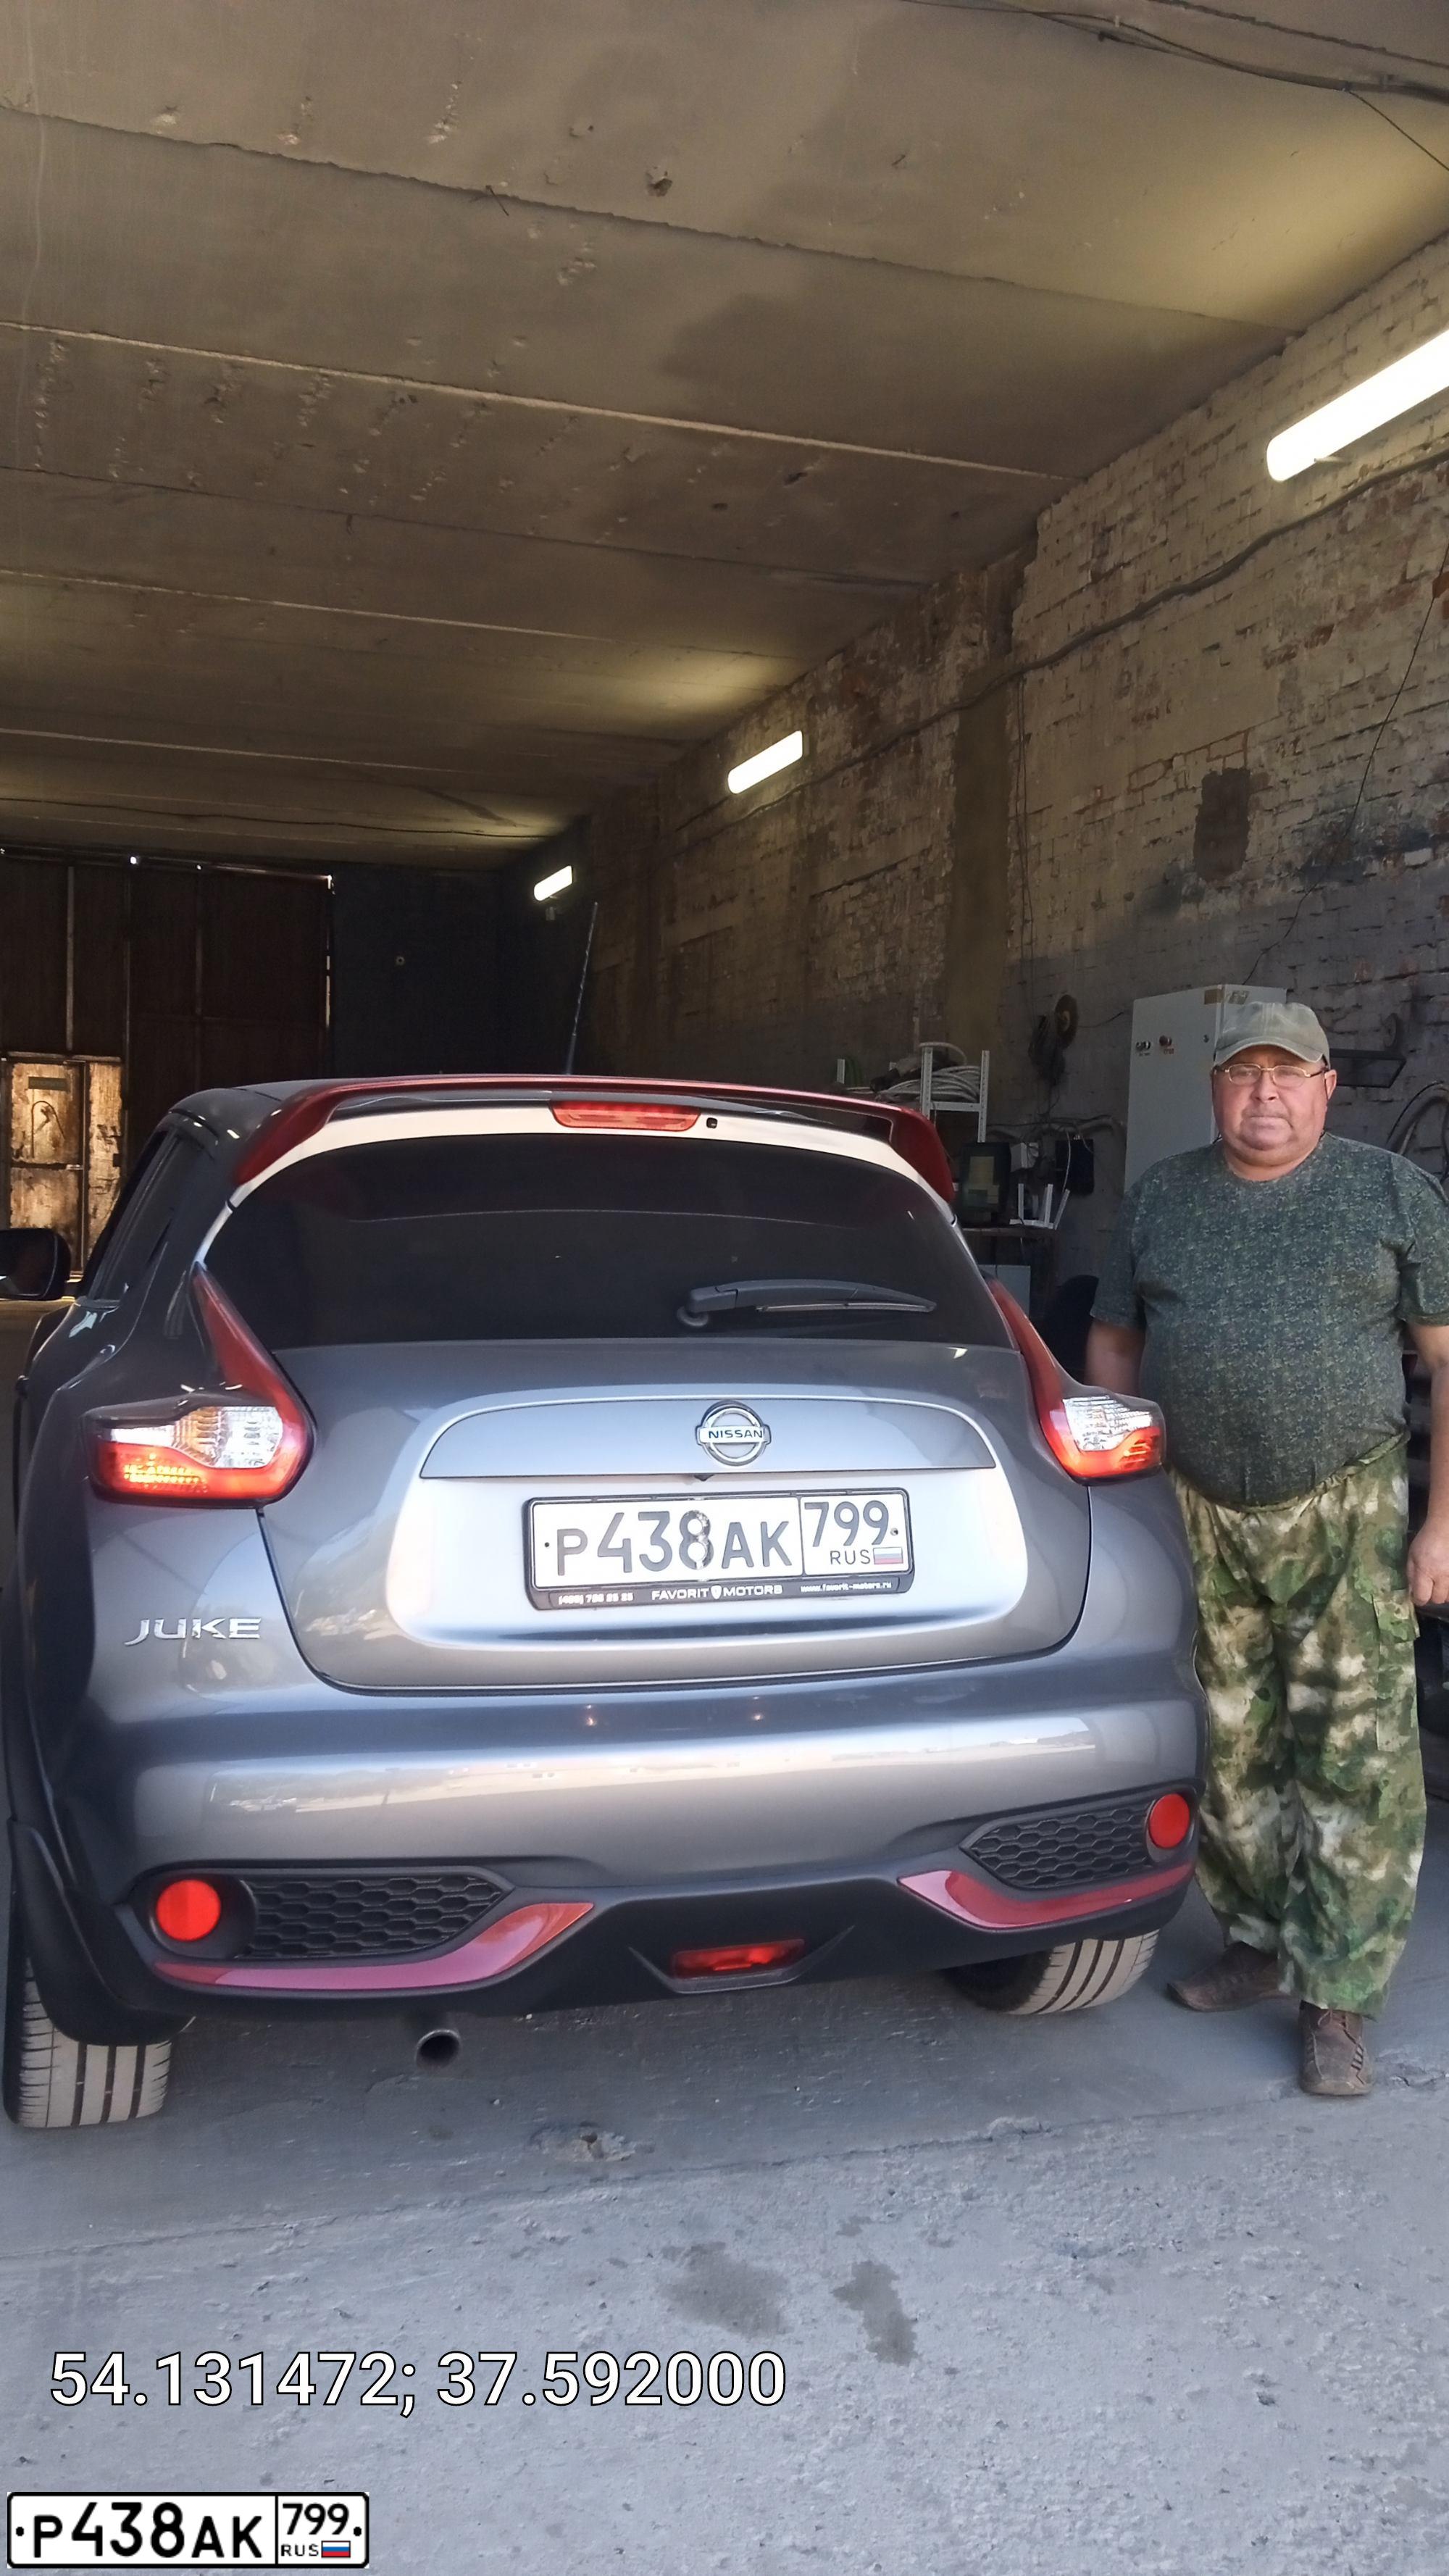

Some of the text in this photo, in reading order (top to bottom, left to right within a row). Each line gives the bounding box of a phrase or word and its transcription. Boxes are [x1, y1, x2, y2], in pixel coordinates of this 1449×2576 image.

[709, 1429, 763, 1439] NISSAN
[803, 1500, 890, 1547] 799
[830, 1549, 872, 1565] RUS
[651, 1584, 783, 1601] FAVORIT MOTORS
[124, 1617, 262, 1646] JUKE
